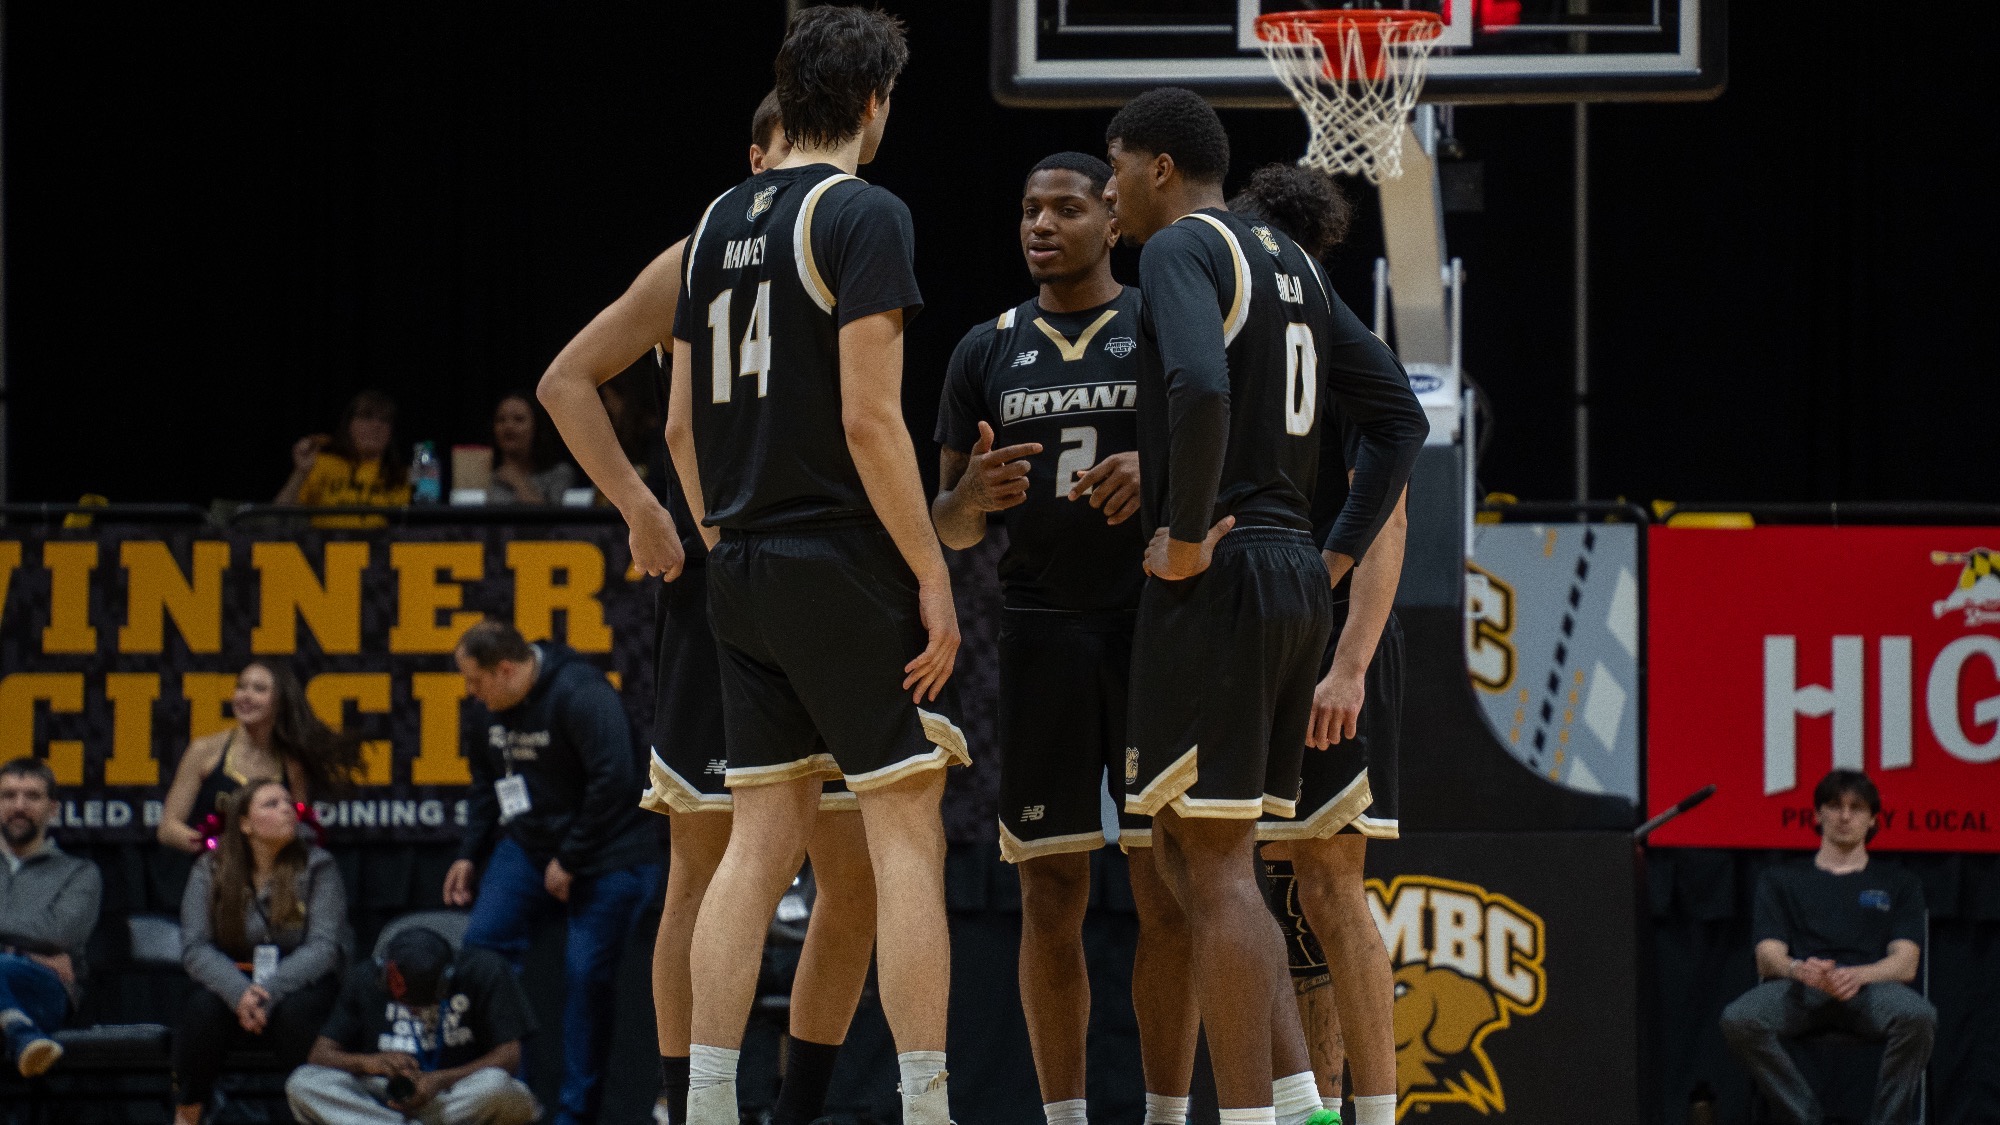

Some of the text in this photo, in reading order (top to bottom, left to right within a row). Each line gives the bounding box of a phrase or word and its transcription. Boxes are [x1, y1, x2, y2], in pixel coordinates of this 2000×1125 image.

[707, 279, 772, 404] 14
[1285, 321, 1318, 437] 0
[1002, 384, 1137, 424] BRYANT
[1055, 425, 1098, 498] 2
[0, 540, 645, 656] INNER
[1908, 807, 1991, 833] LOCAL
[1366, 884, 1537, 1005] MBC
